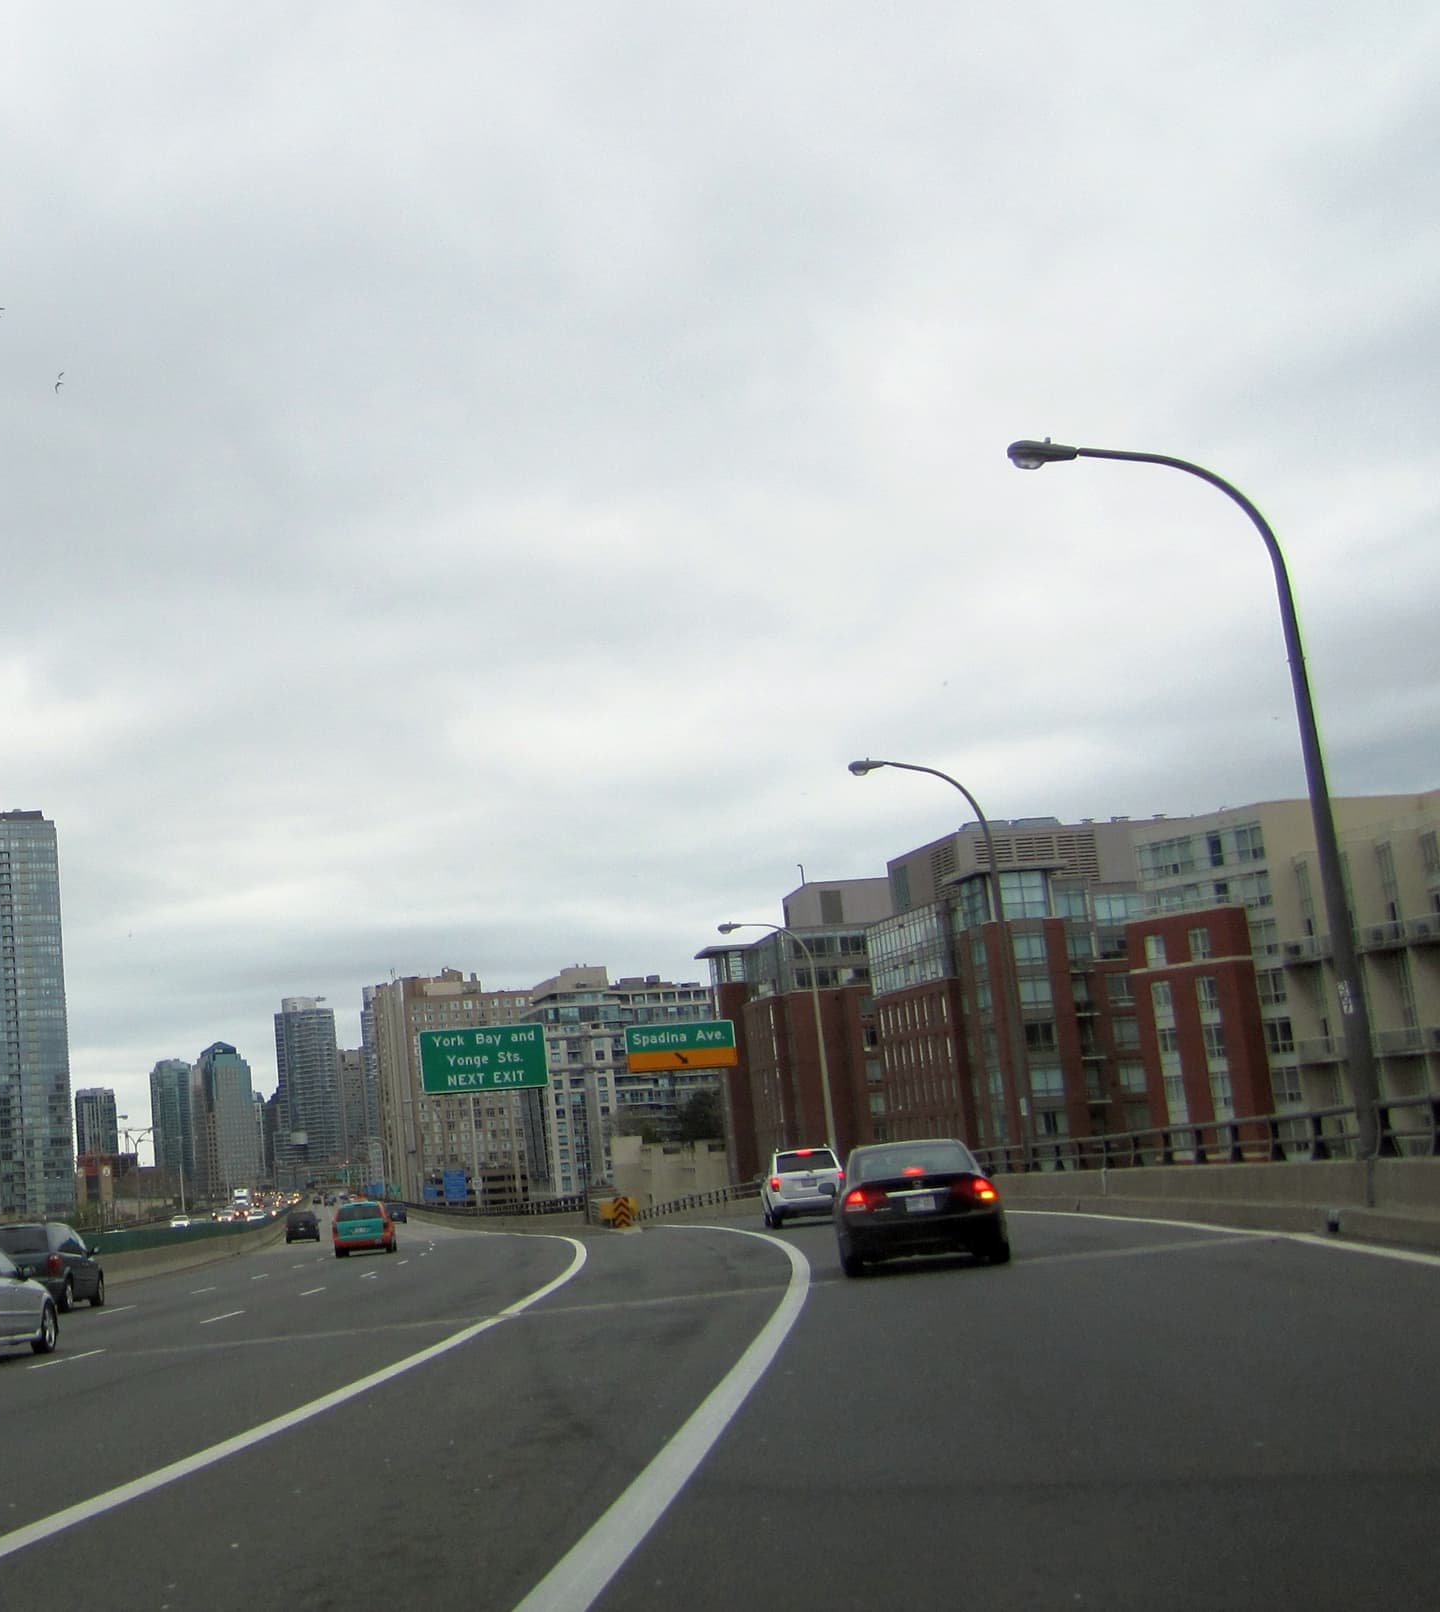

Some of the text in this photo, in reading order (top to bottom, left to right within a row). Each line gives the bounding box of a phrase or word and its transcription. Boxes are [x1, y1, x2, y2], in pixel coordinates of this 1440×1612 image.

[432, 1030, 535, 1047] York Bay and
[632, 1029, 725, 1047] Spadina Ave.
[447, 1051, 524, 1067] Yonge Sts.
[448, 1070, 525, 1086] NEXT EXIT
